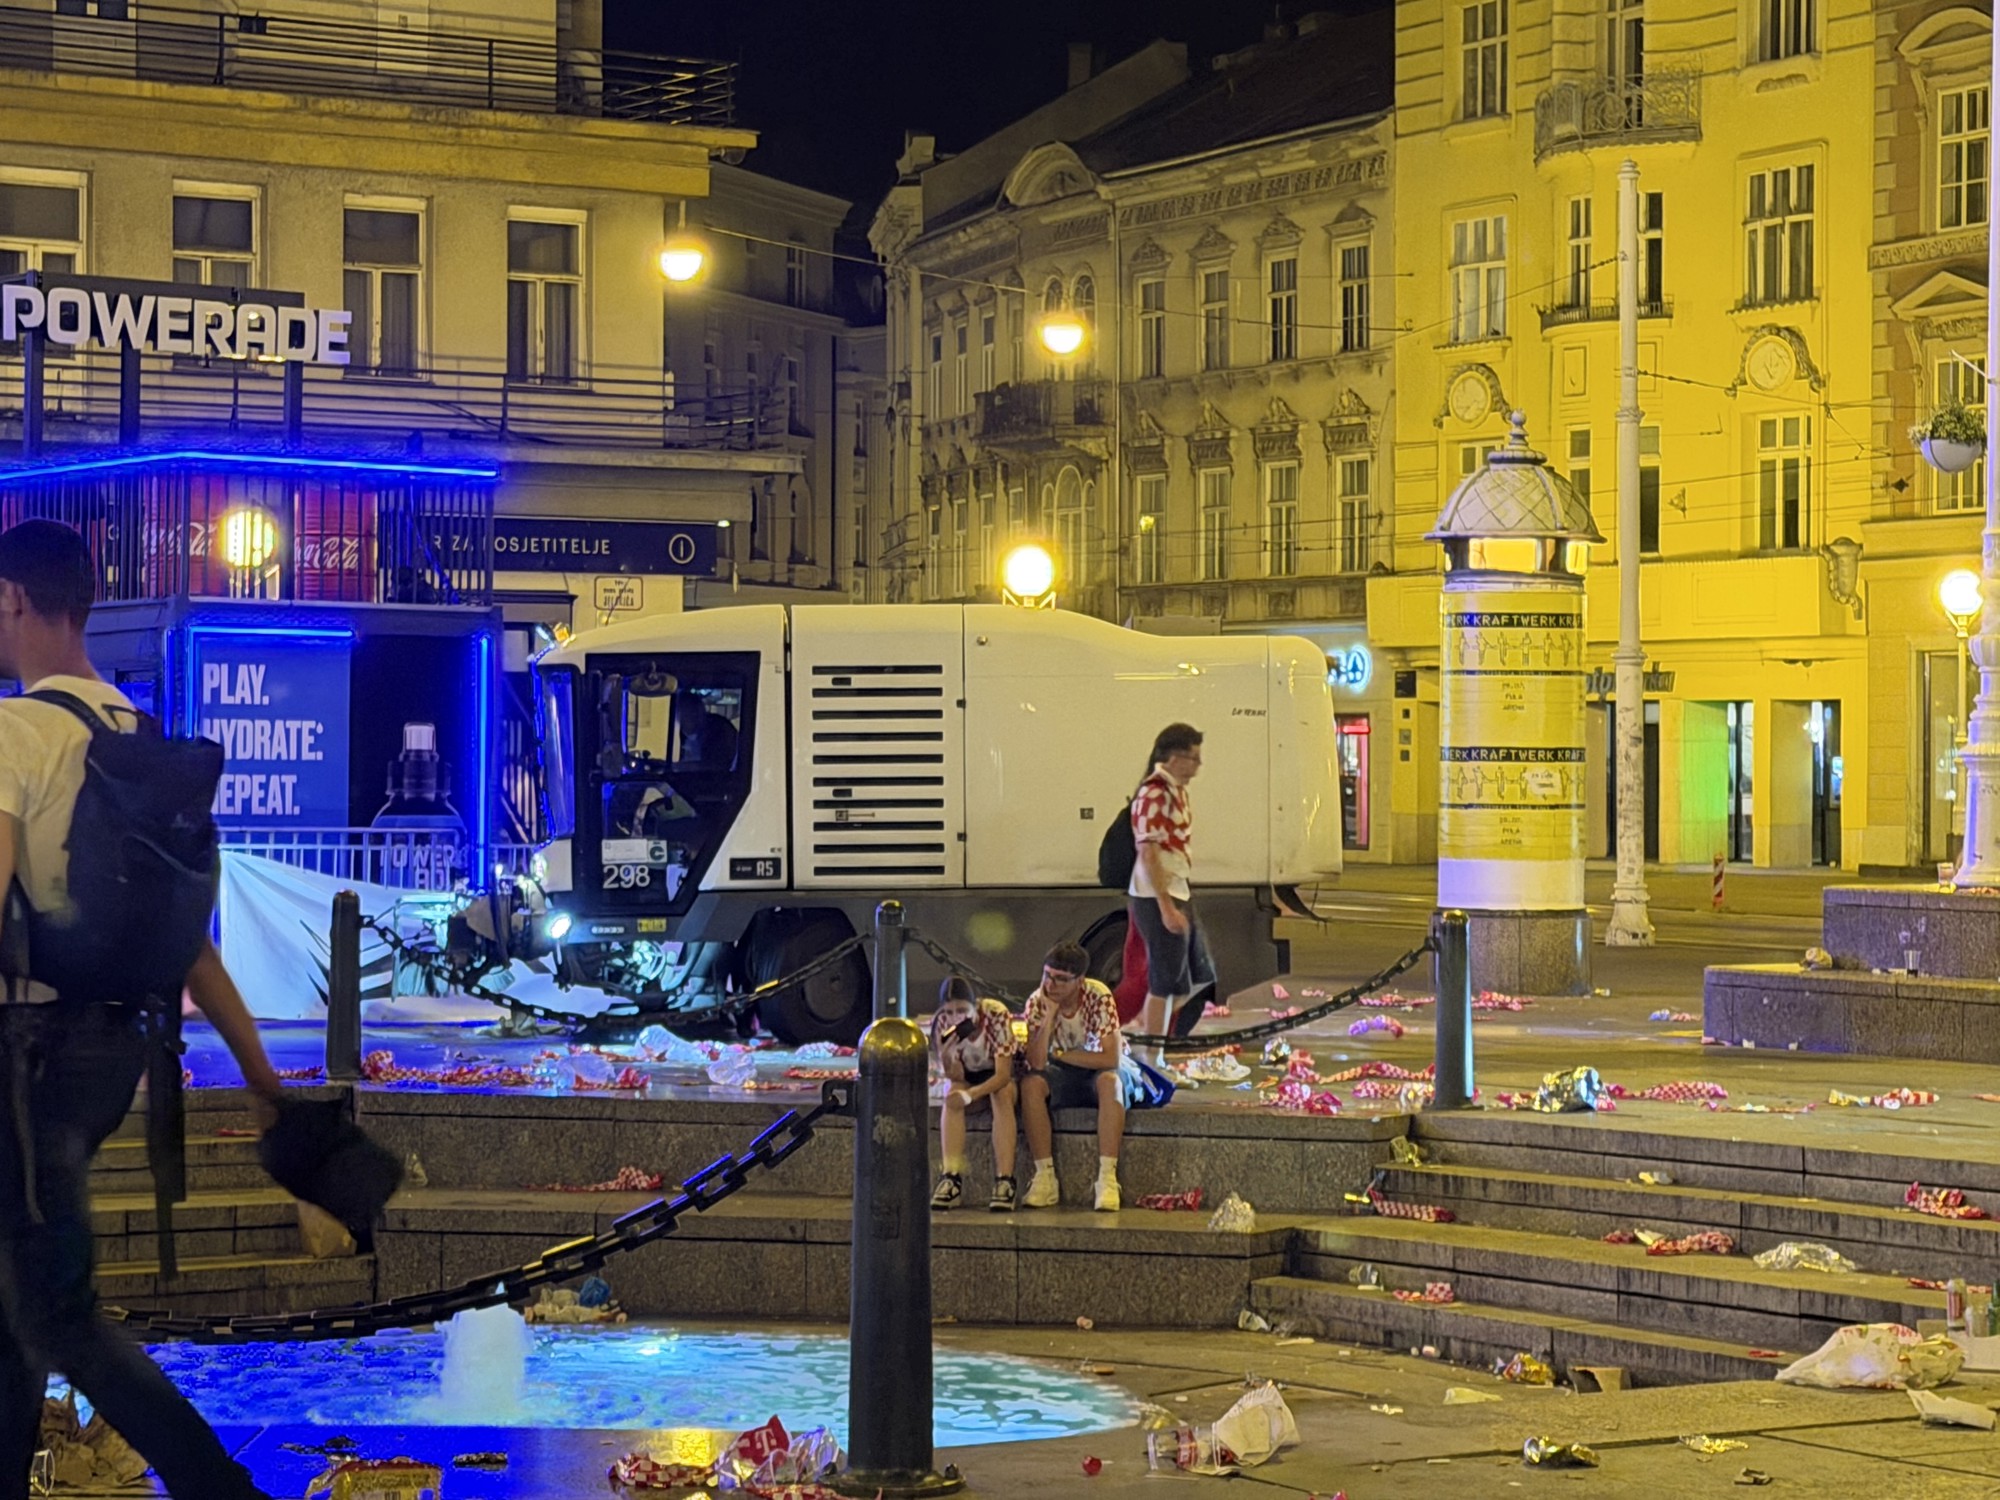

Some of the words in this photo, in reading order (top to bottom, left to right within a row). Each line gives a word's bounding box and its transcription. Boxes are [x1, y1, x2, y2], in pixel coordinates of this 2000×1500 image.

[2, 283, 352, 365] POWERADE
[483, 535, 611, 554] OSJETITELJE
[1473, 613, 1557, 628] KRAFTWERK
[203, 663, 269, 705] PLAY.
[1471, 749, 1555, 761] KRAFTWERK
[211, 773, 300, 816] EPEAT.
[603, 865, 651, 889] 298
